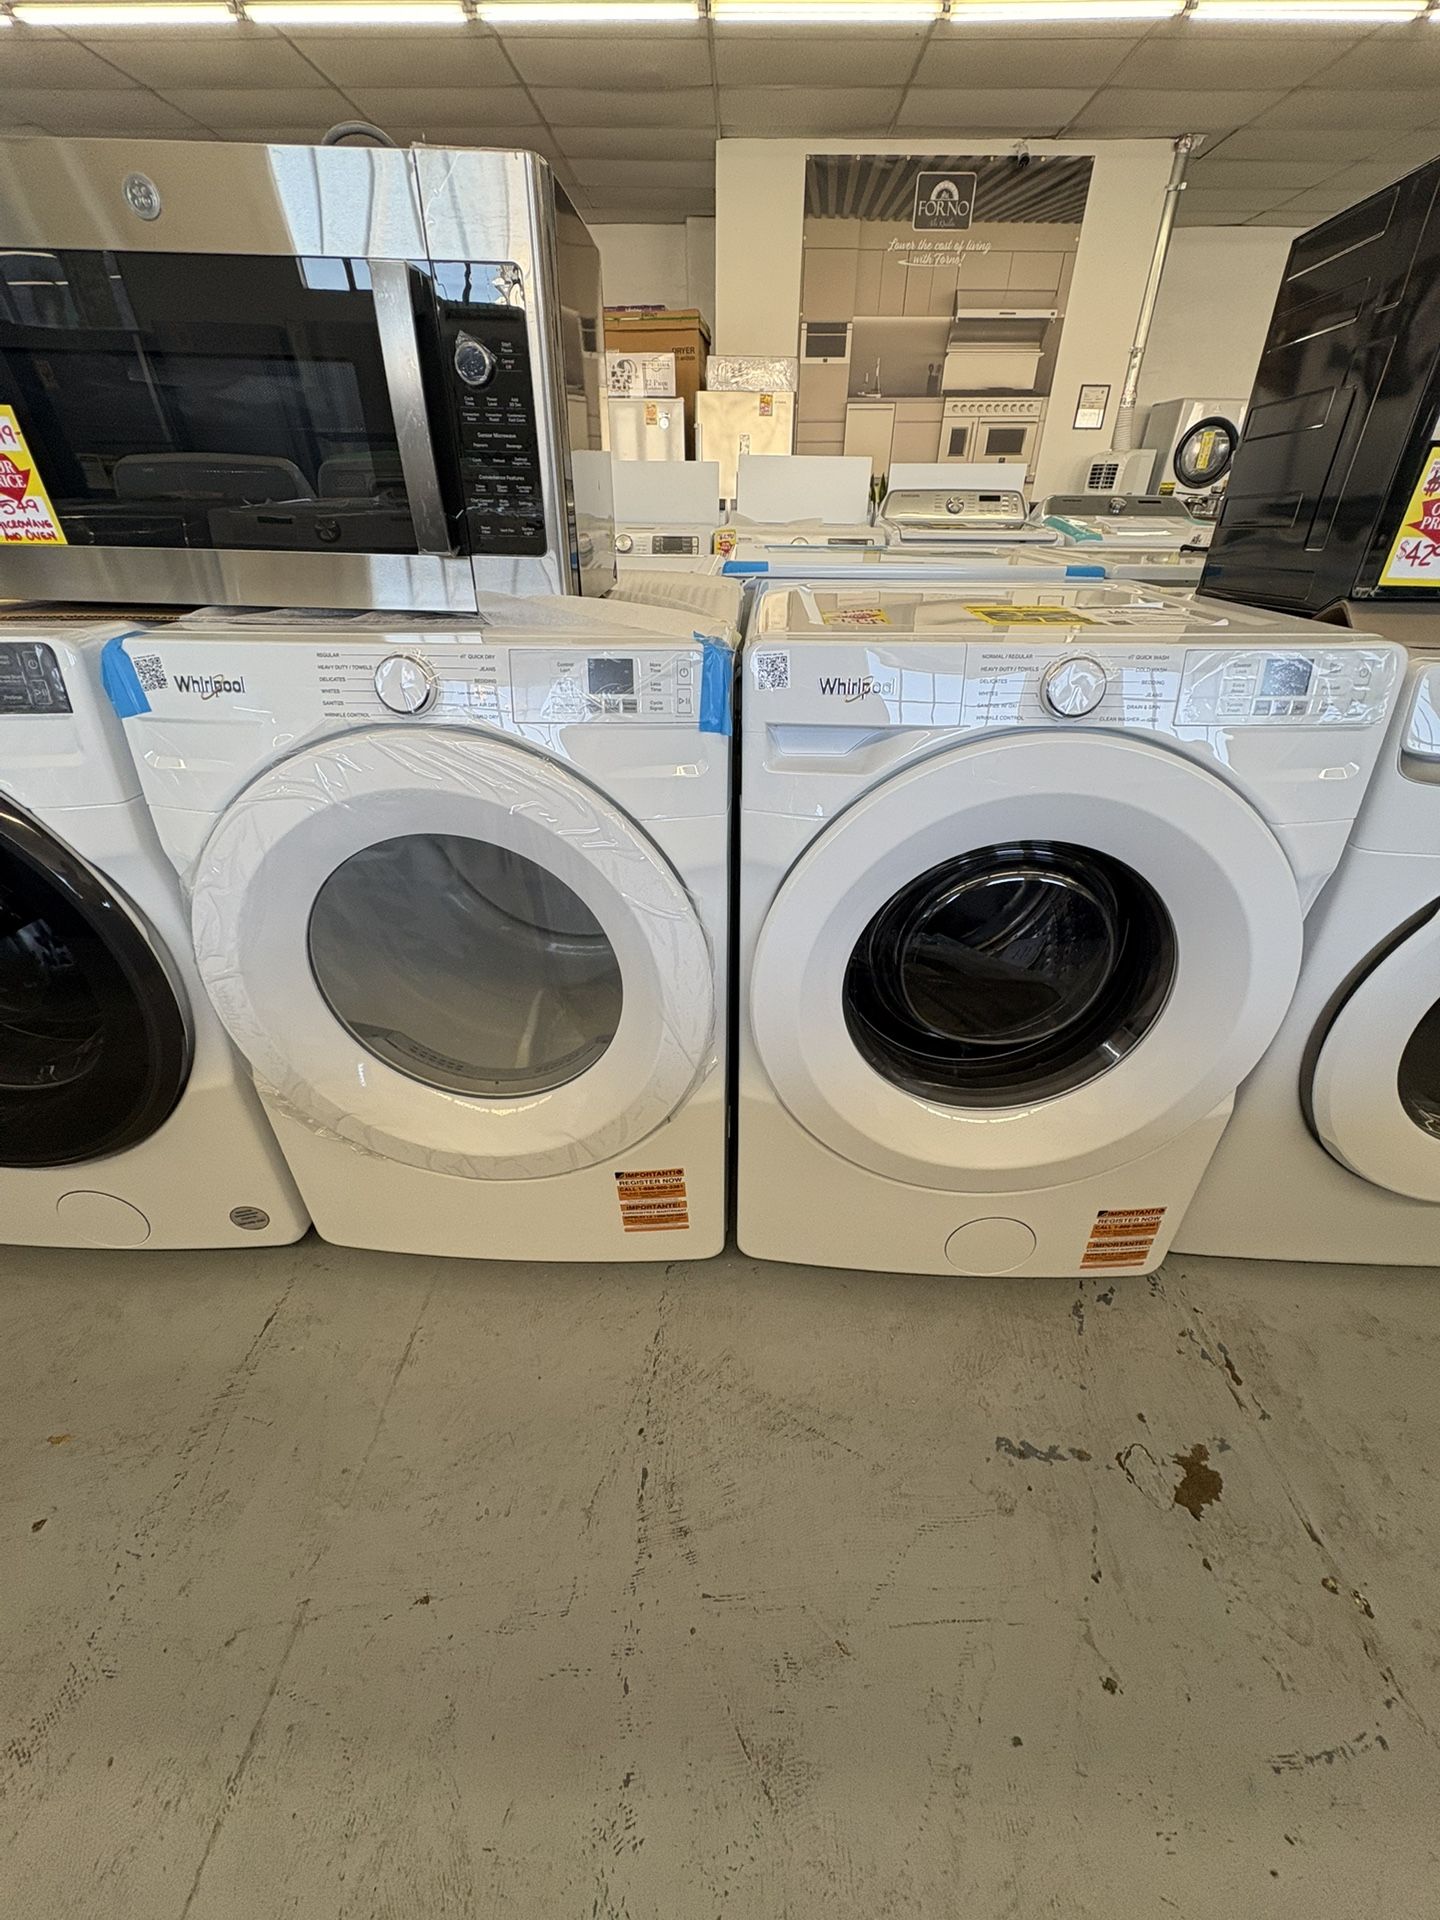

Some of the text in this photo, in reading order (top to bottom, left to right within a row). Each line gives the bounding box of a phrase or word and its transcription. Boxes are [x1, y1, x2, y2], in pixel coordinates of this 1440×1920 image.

[918, 200, 970, 217] FORNO
[887, 237, 992, 255] Lower the cost of living
[913, 253, 967, 268] with Forno!
[671, 346, 696, 355] DRYER
[173, 674, 246, 699] Whirlpool
[819, 676, 897, 702] Whirlpool
